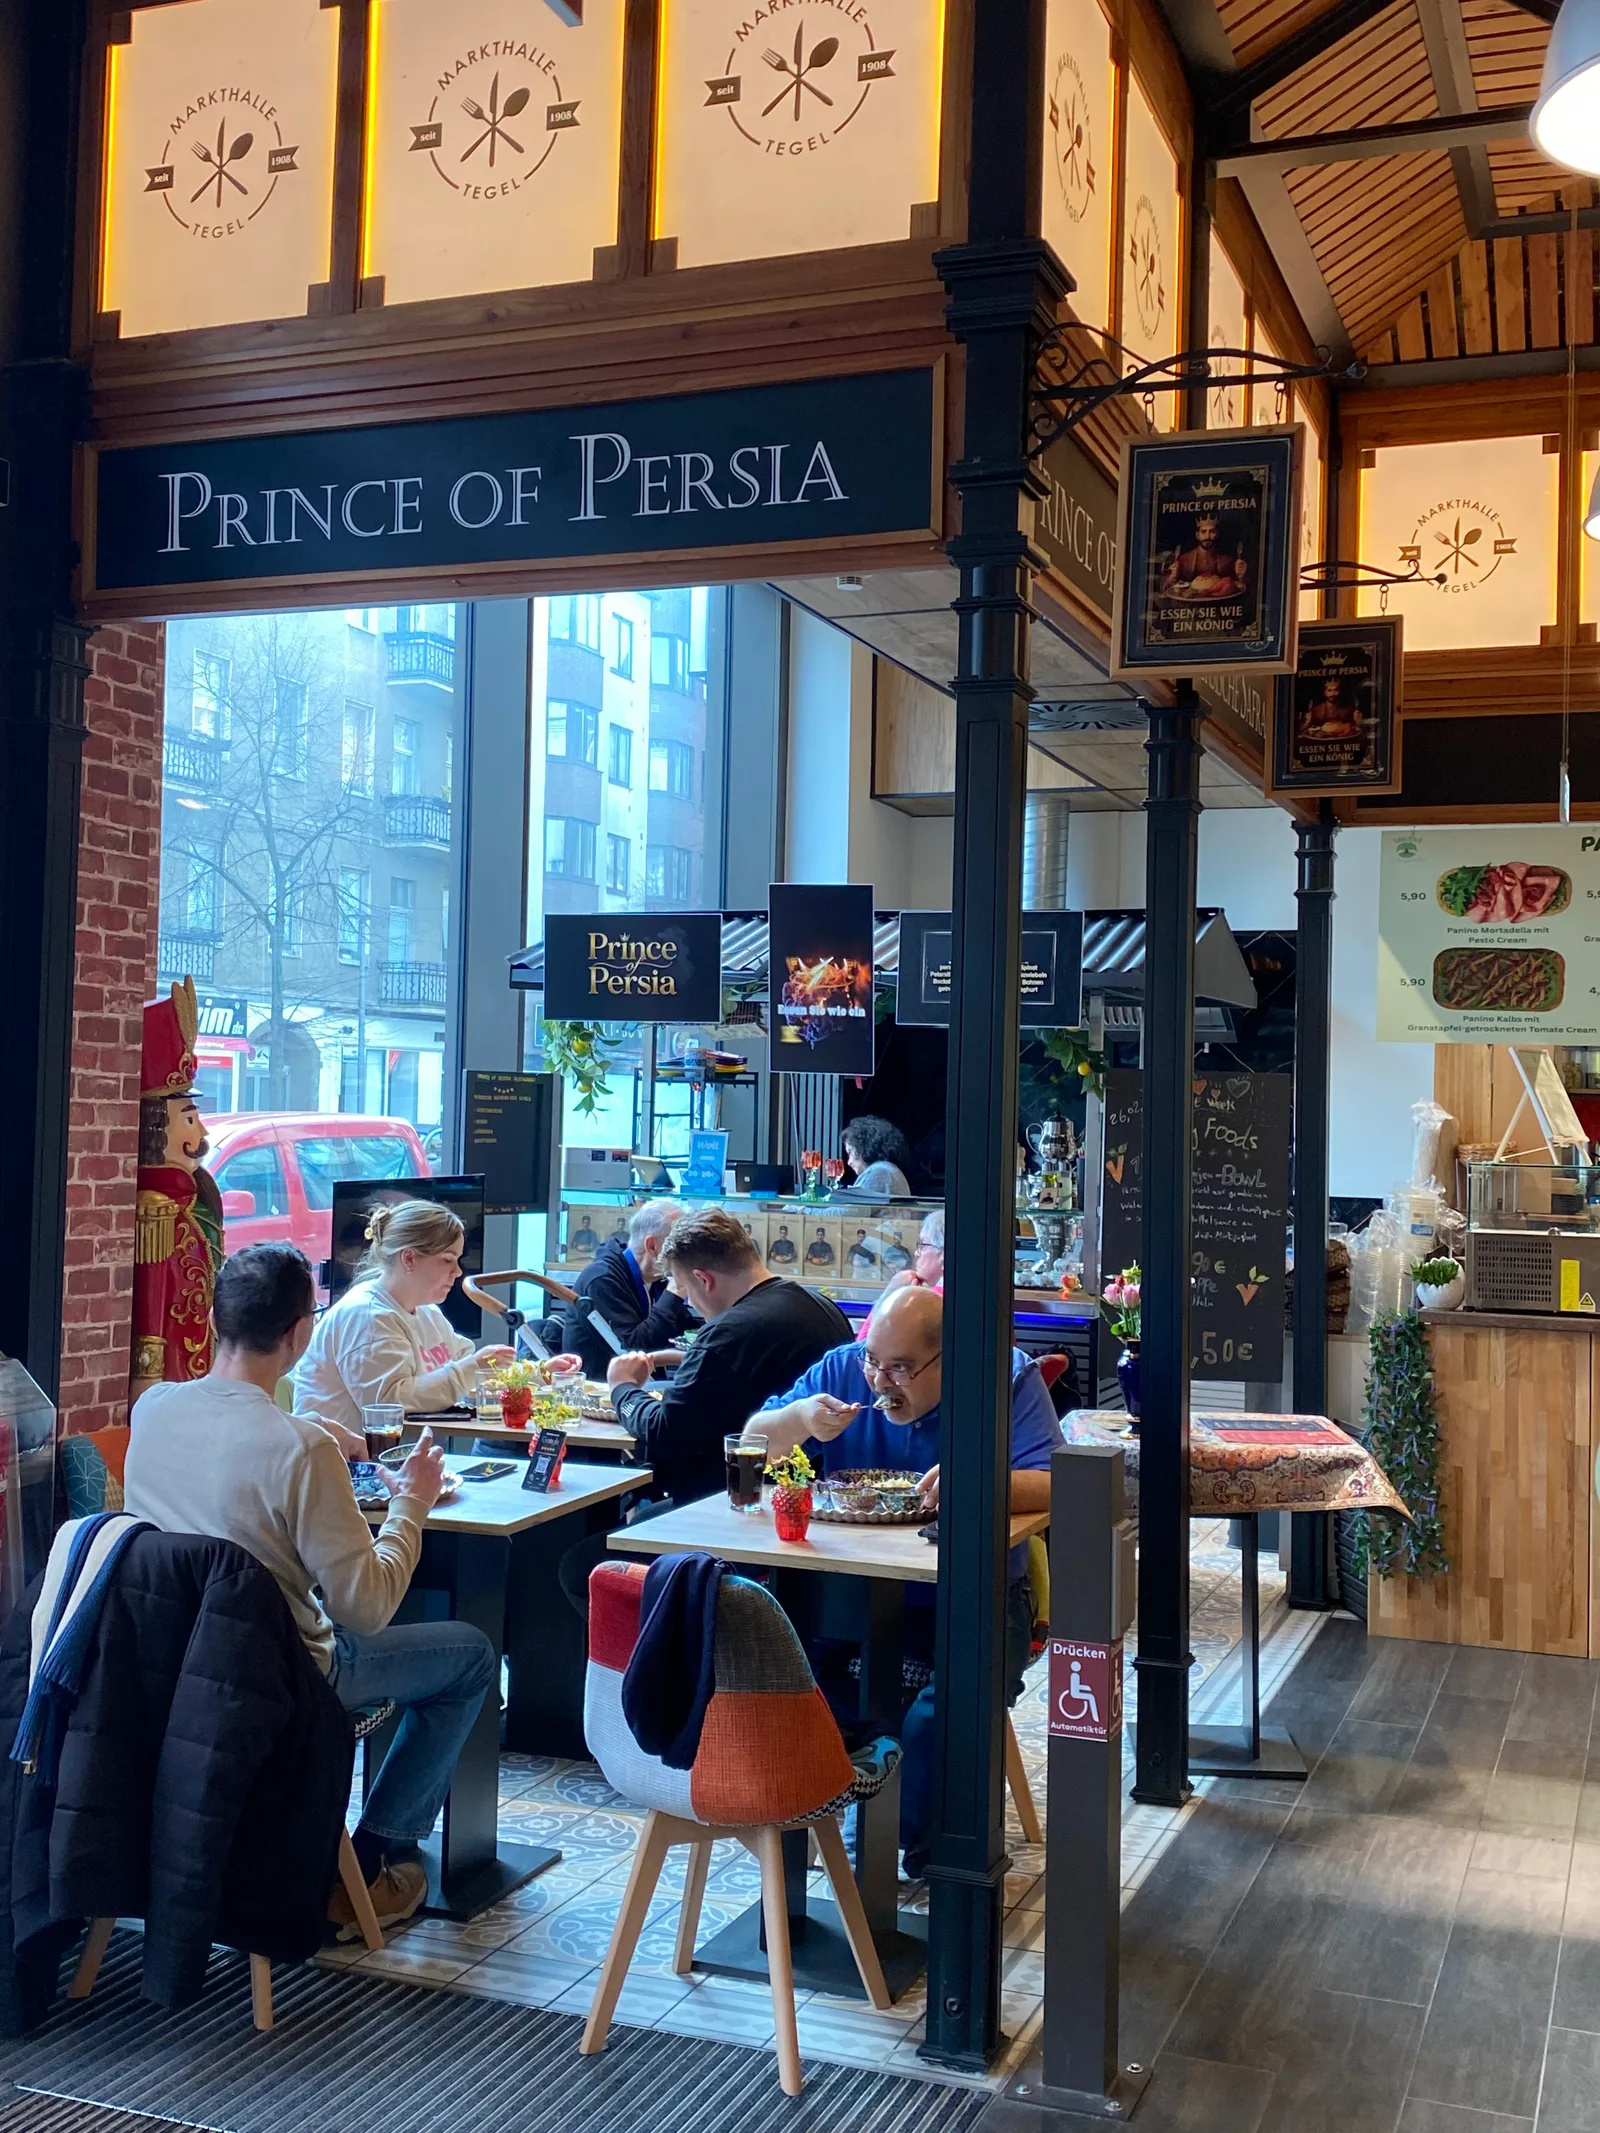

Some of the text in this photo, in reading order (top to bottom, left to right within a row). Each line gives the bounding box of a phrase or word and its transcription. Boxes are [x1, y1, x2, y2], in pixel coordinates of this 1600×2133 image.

[735, 0, 867, 42] MARKALLE
[437, 40, 556, 91] MARKTHALLE
[861, 59, 886, 73] 1908
[716, 84, 735, 96] seit
[170, 87, 277, 135] MARKTHALLE
[550, 110, 572, 123] 1908
[420, 130, 437, 141] seit
[765, 132, 830, 156] TEGEL
[271, 154, 292, 166] 1908
[154, 172, 169, 183] seit
[463, 178, 520, 200] TEGEL
[192, 218, 244, 239] TEGEL
[157, 431, 850, 553] PRINCE OF PERSIA
[1162, 501, 1200, 514] PRINCE
[1217, 498, 1256, 511] PERSIA
[1417, 499, 1500, 527] MARKTHALLE
[1160, 605, 1243, 620] ESSEN SIE WIE
[1173, 618, 1234, 633] EIN KÖNIG
[1298, 668, 1327, 678] PRINCE
[1339, 666, 1368, 676] PERSIA
[1300, 743, 1360, 754] ESSEN SIE WIE
[1309, 751, 1354, 763] EIN KÖNIG
[1401, 892, 1426, 901] 5,90
[587, 932, 678, 960] Prince
[625, 954, 646, 976] of
[587, 966, 678, 995] Persia
[1400, 978, 1425, 987] 5,90
[1463, 1015, 1494, 1023] Panino
[1496, 1015, 1522, 1023] Kalbs
[1407, 1024, 1527, 1034] Granatapfel-getrockneten
[1566, 1026, 1597, 1034] Cream
[1204, 1118, 1258, 1151] Foods
[1053, 1643, 1107, 1660] Drücken
[1050, 1721, 1107, 1735] Automatiktür
